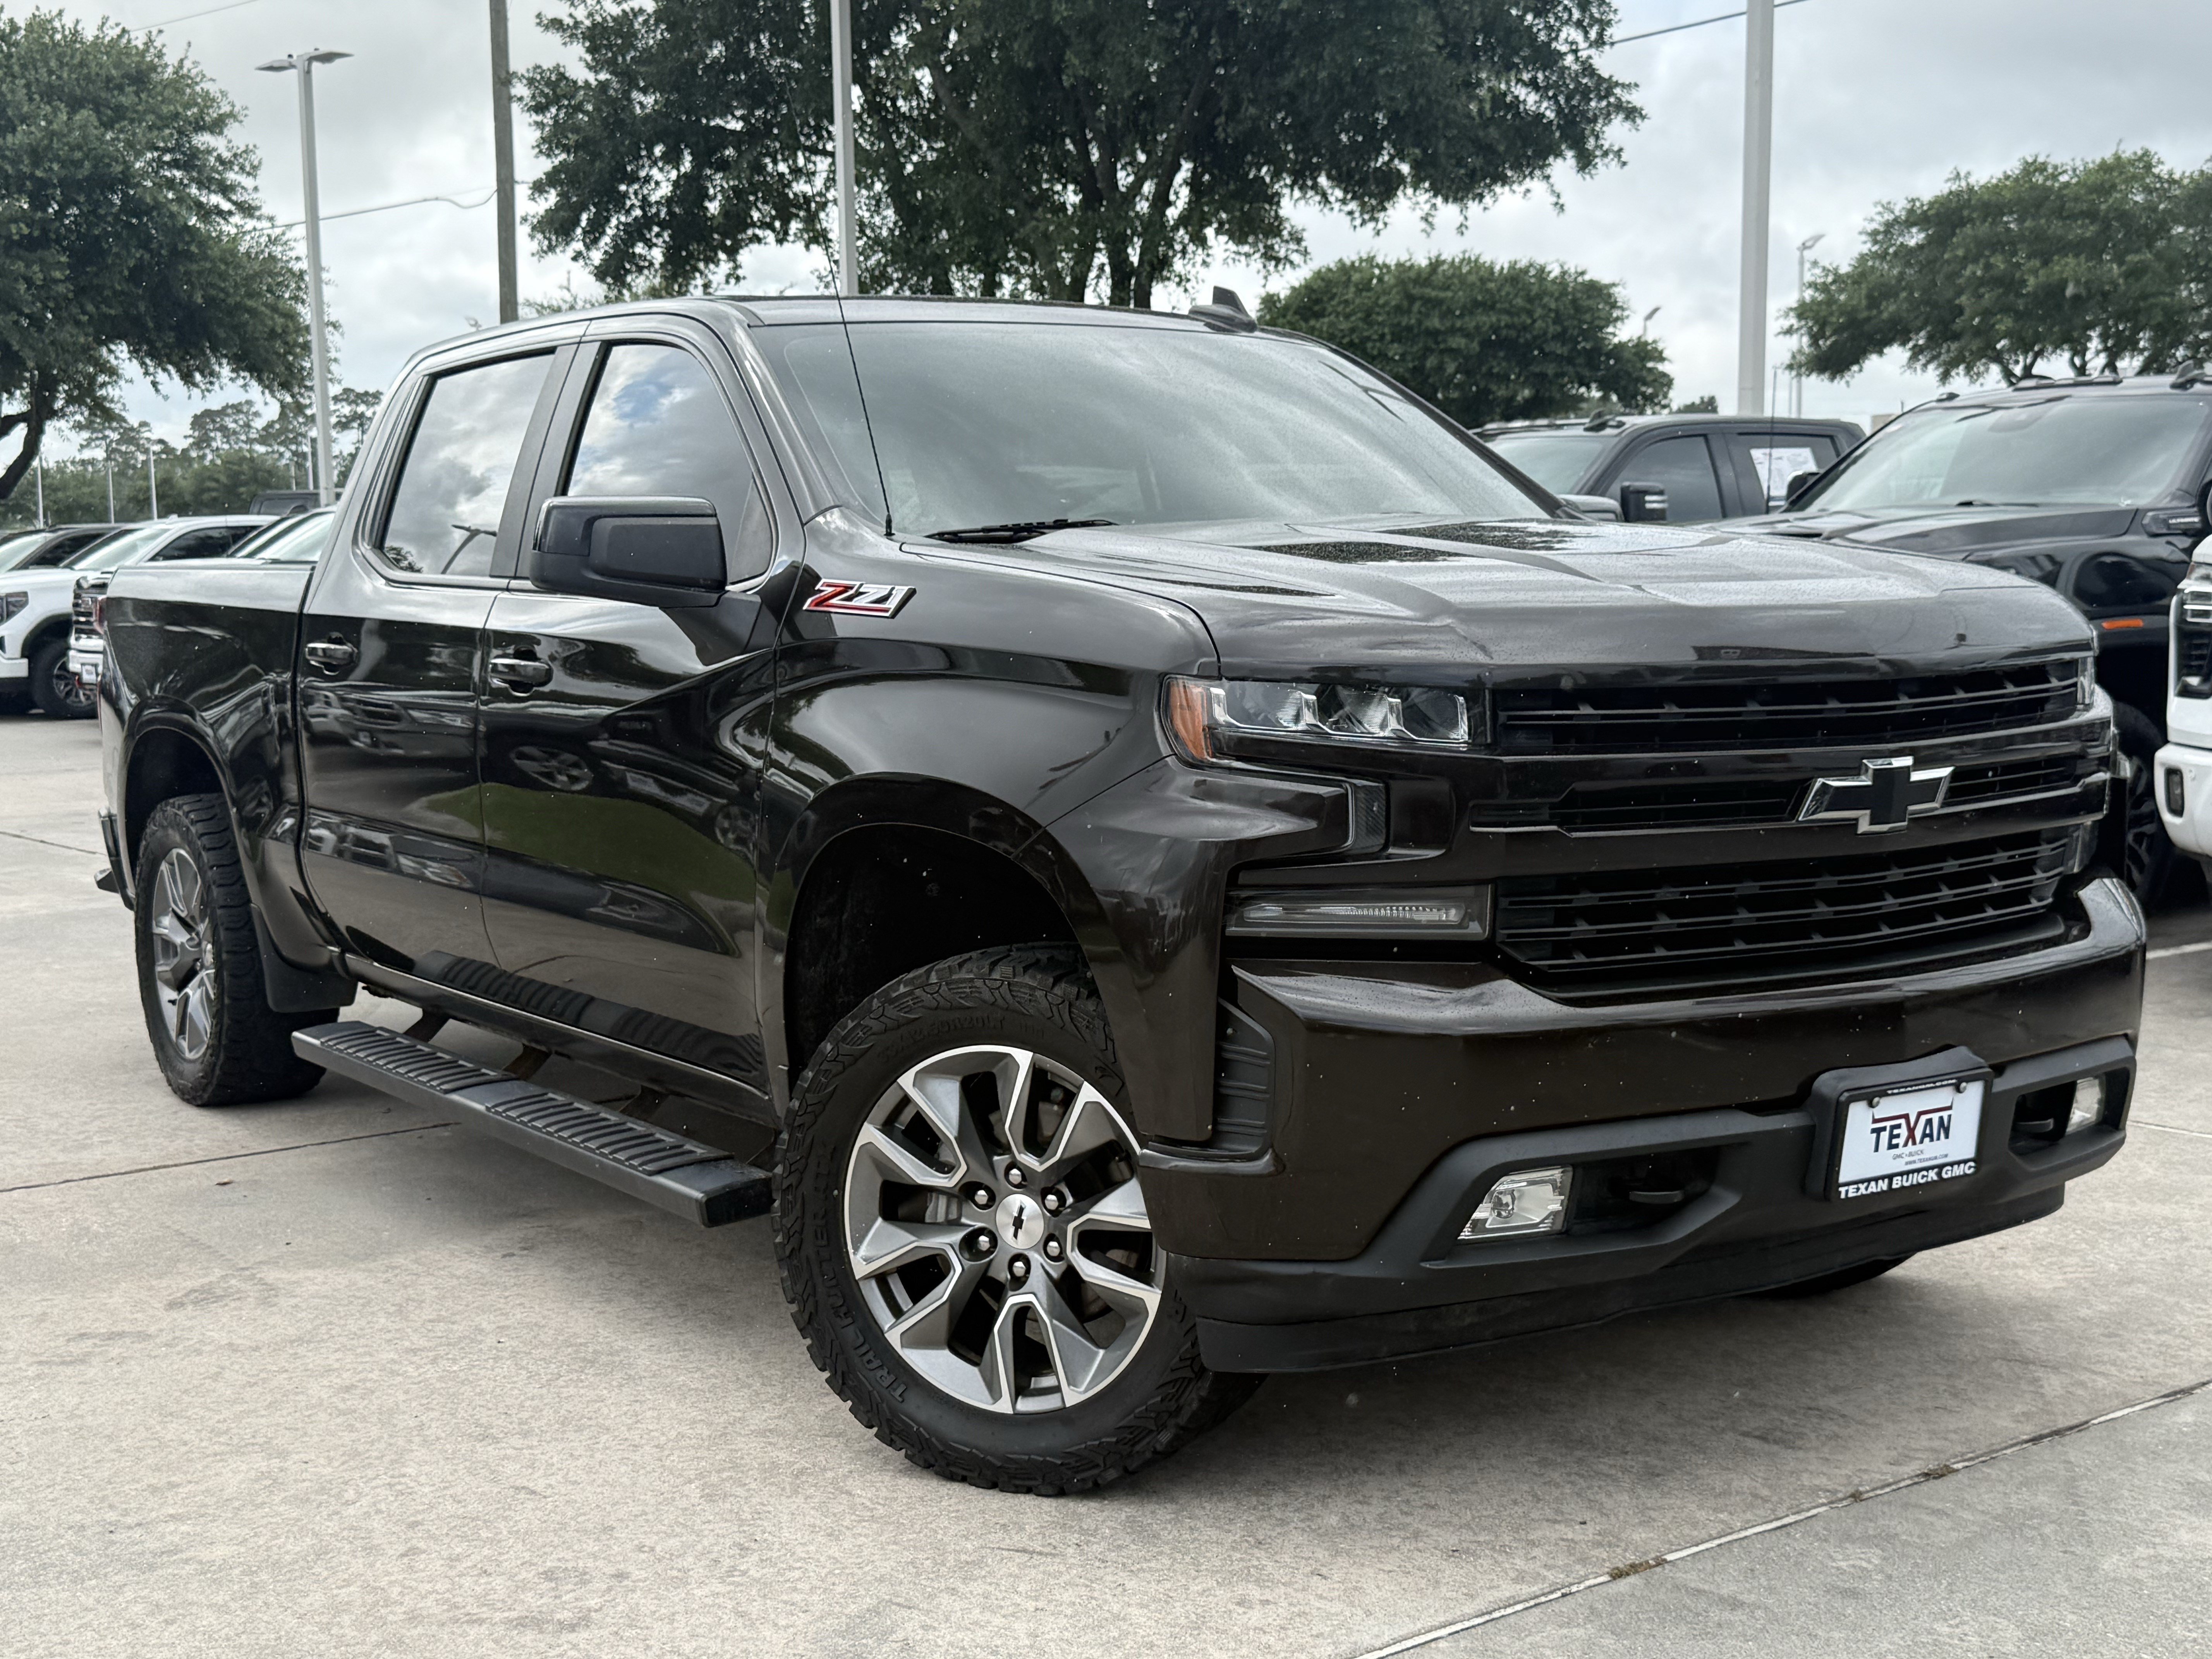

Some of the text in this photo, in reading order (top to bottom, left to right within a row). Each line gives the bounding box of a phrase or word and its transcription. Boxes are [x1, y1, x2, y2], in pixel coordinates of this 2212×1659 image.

[802, 578, 917, 619] Z71
[1870, 1112, 1953, 1153] TEXAN
[1838, 1161, 1977, 1199] TEXAN BUICK GMC
[812, 1207, 854, 1330] HUNTER
[853, 1327, 907, 1404] TRAIL
